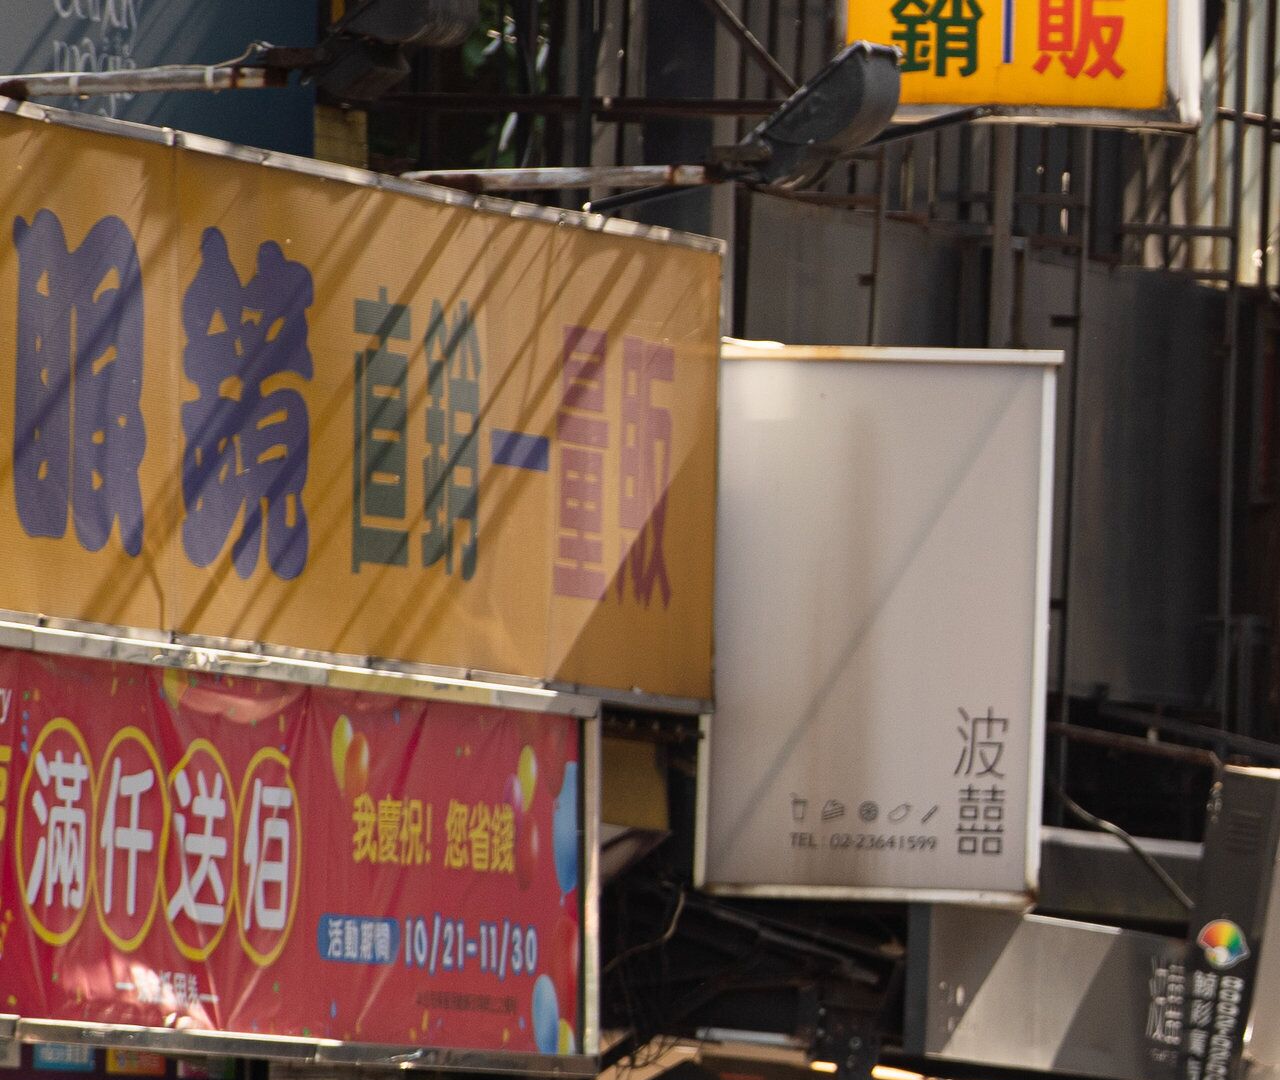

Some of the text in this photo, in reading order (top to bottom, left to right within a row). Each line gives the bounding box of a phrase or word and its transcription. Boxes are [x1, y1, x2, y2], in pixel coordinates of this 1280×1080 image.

[26, 749, 294, 931] 滿仟送佰
[404, 911, 538, 981] 10/21-11/30
